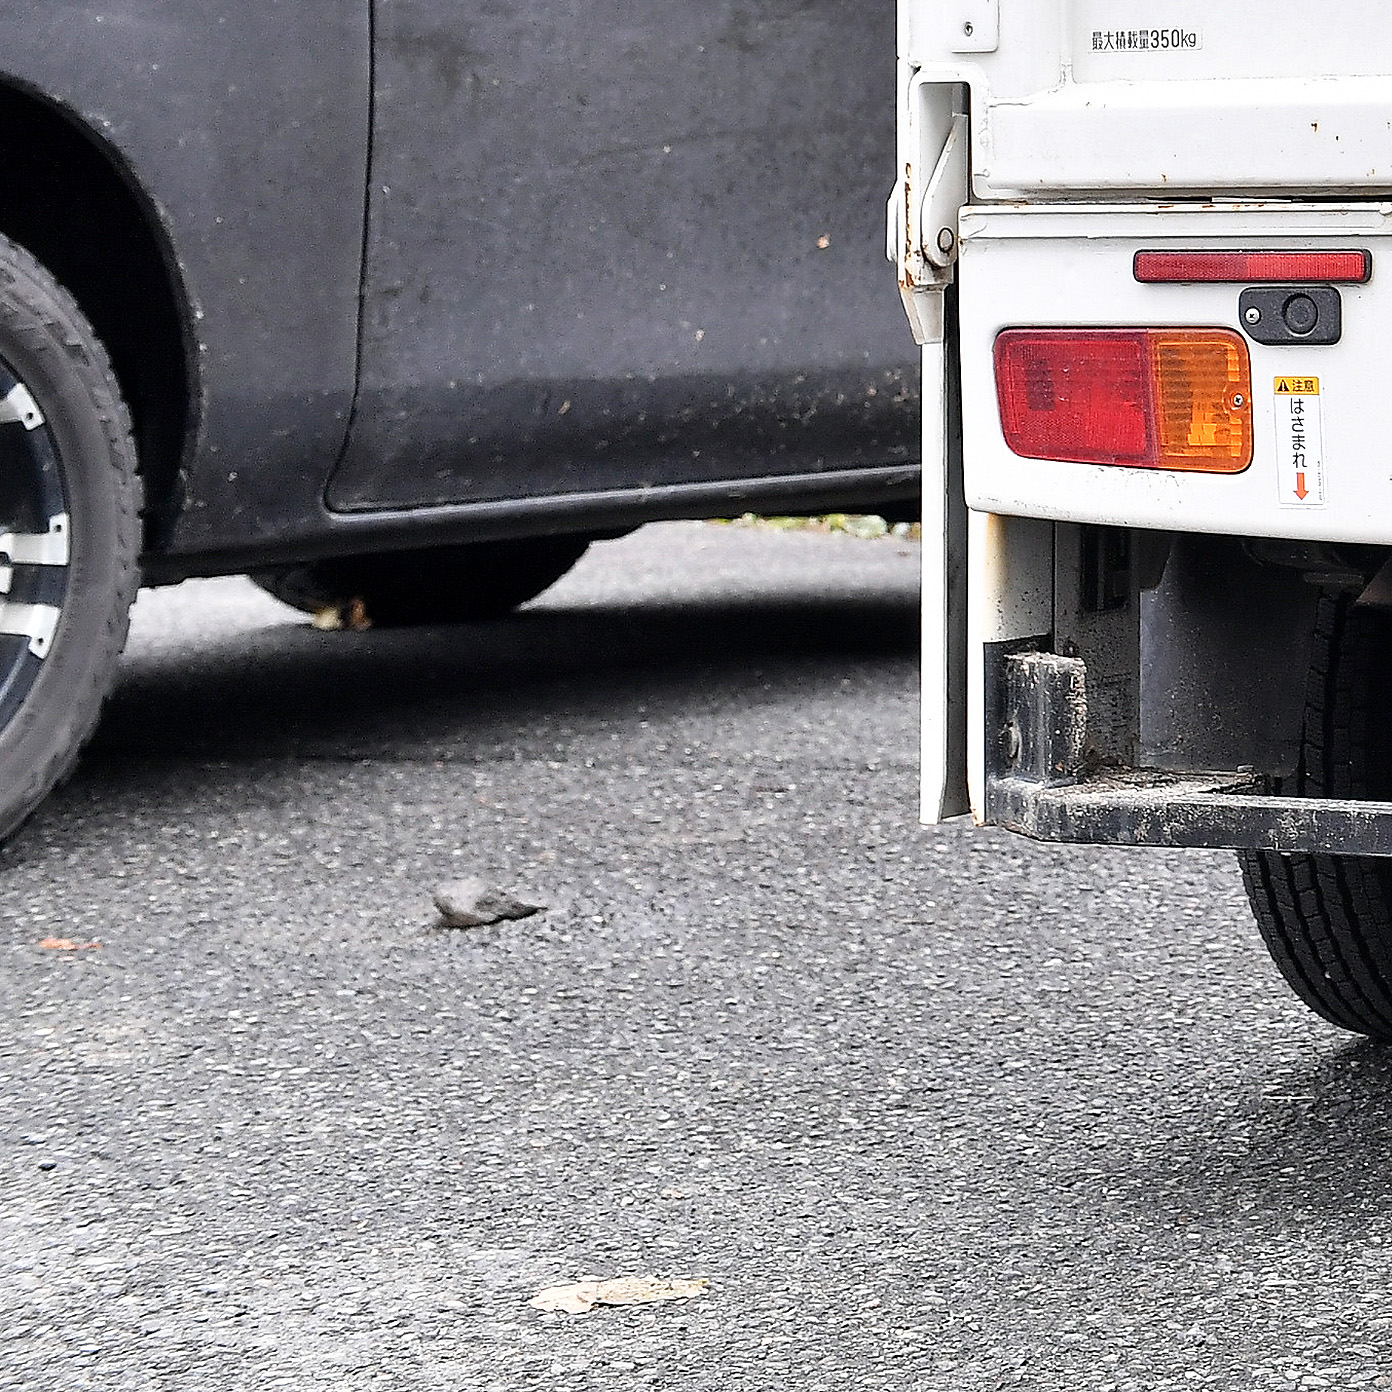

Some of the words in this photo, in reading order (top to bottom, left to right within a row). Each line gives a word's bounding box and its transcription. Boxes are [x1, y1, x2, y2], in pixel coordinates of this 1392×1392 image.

[1292, 379, 1315, 392] 注意
[1290, 397, 1308, 469] はさまれ
